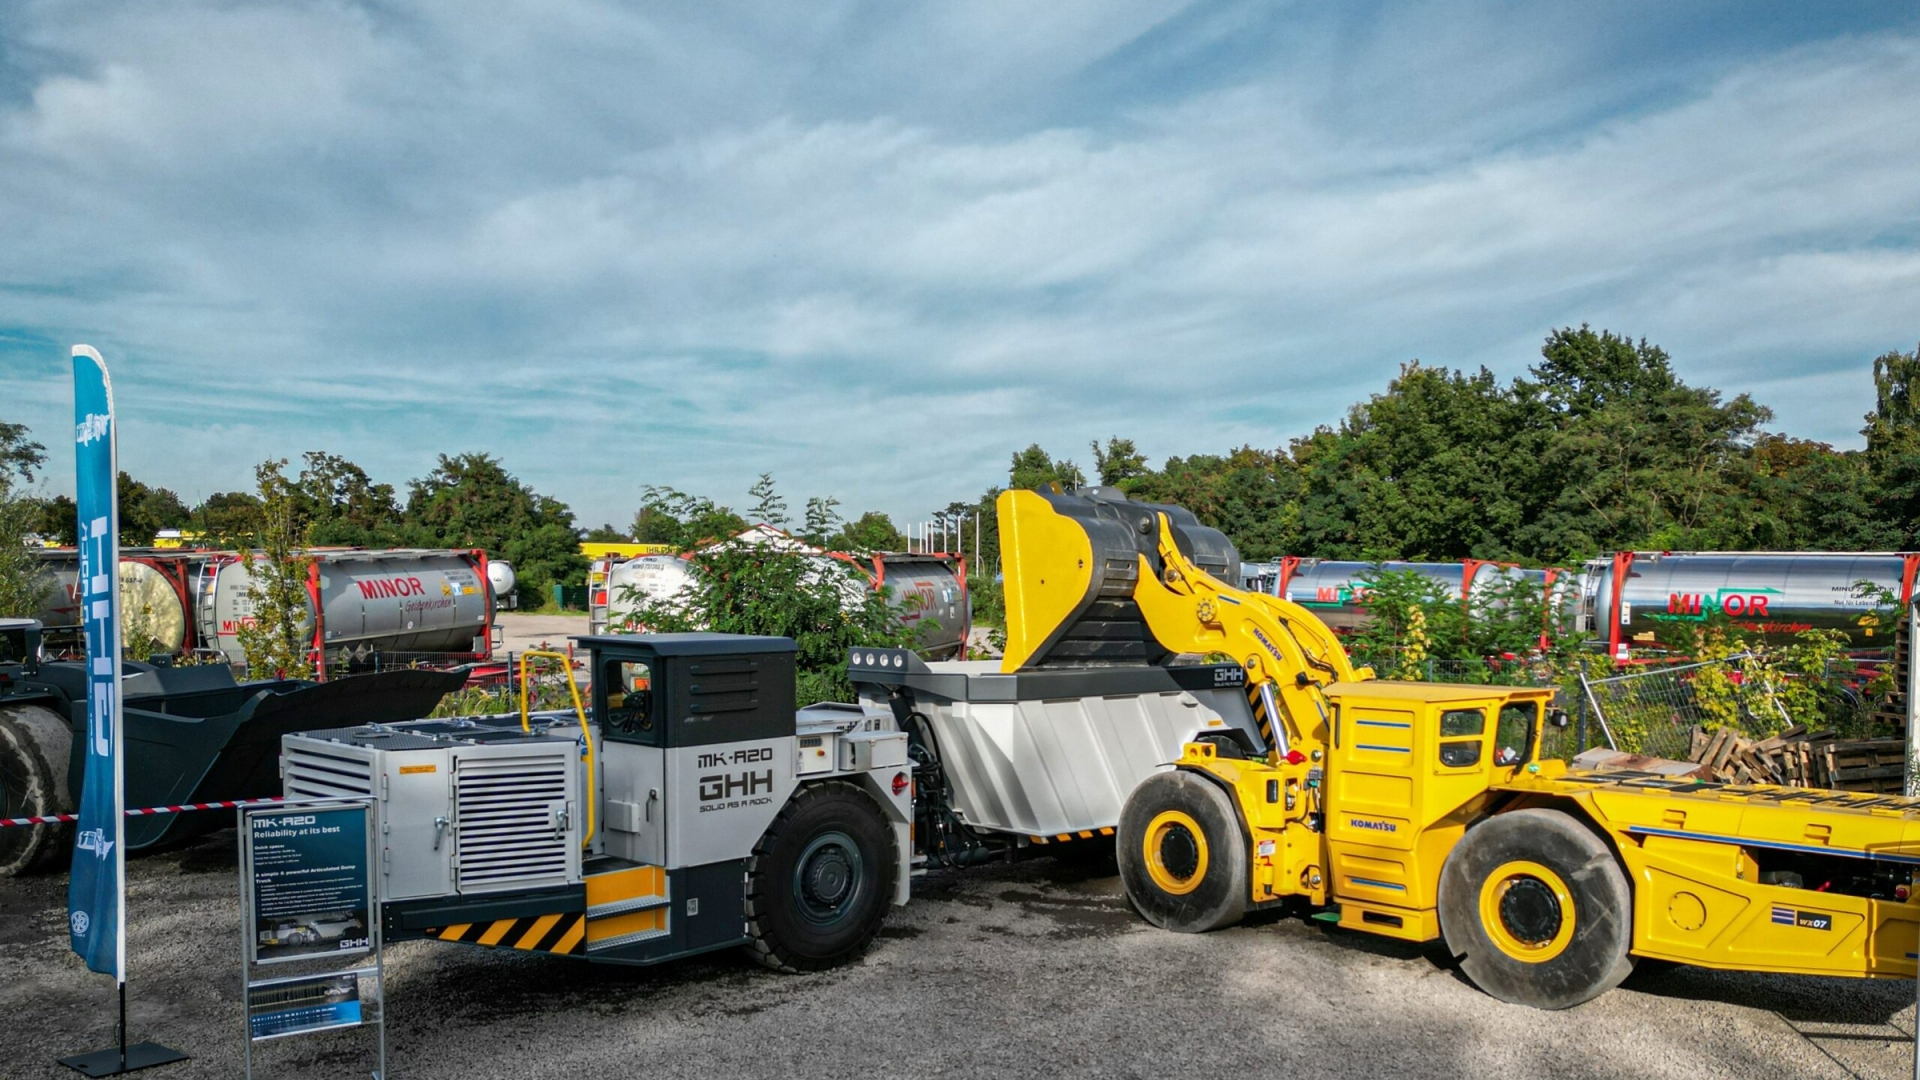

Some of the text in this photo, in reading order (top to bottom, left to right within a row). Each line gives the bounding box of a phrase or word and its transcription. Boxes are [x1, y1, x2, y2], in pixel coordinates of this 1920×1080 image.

[357, 577, 425, 600] MINOR
[1317, 586, 1375, 604] MINO
[1667, 592, 1769, 616] MINOR
[1253, 628, 1283, 661] KOMATSU
[1214, 668, 1244, 682] GHH
[698, 747, 773, 769] MK-A20
[699, 769, 773, 801] GHH
[699, 803, 725, 813] SOLID
[727, 801, 739, 809] AS
[749, 797, 773, 806] ROCK
[253, 815, 316, 829] MK-A20
[1350, 819, 1397, 832] KOMATSU
[254, 829, 297, 839] Reliability
[298, 828, 308, 836] at
[322, 826, 341, 834] best
[286, 868, 310, 876] powerful
[310, 865, 340, 874] Articulated
[340, 937, 369, 948] GHH
